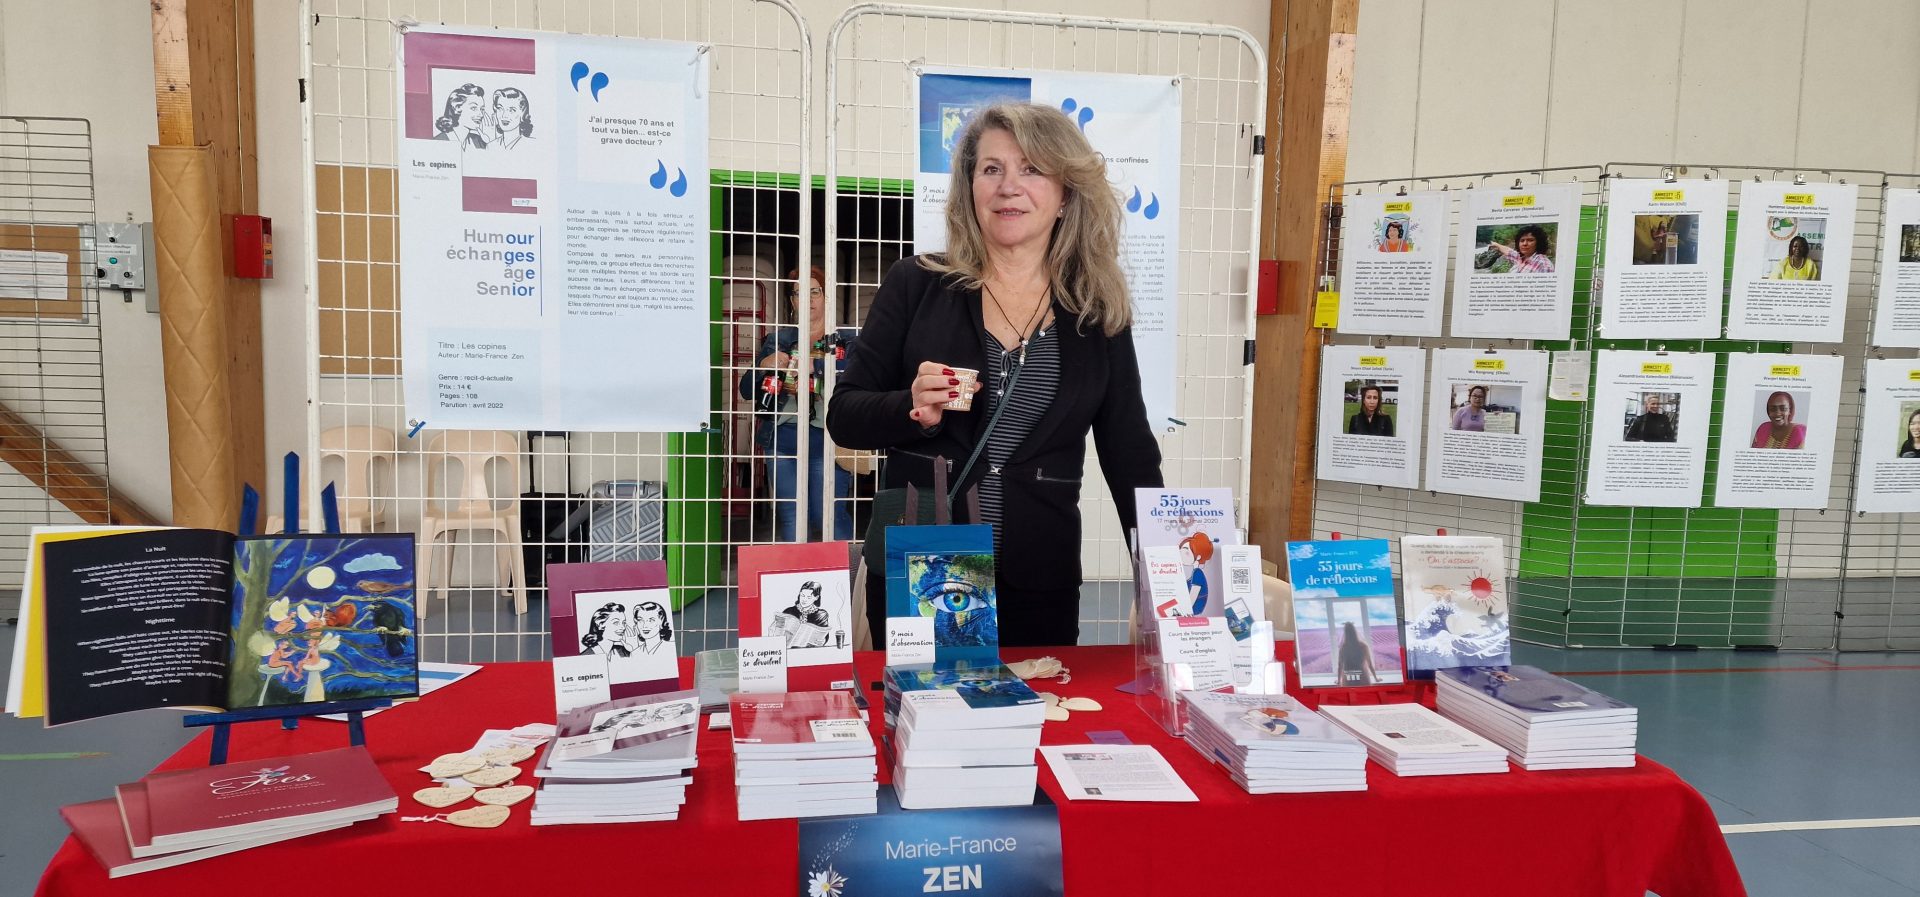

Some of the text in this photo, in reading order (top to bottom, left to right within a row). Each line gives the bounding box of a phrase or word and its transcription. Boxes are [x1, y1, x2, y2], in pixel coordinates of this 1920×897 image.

[589, 115, 602, 123] J'ai
[430, 161, 456, 169] copines
[464, 229, 534, 244] Humour
[447, 245, 535, 265] échanges
[504, 264, 535, 282] âge
[477, 281, 535, 296] Senior
[1160, 495, 1211, 508] 55 jours
[1150, 507, 1224, 517] de réflexions
[1318, 561, 1363, 573] 55 jours
[1306, 574, 1377, 585] de réflexions
[145, 617, 175, 625] Nighttime
[742, 649, 782, 658] Les copines
[753, 657, 782, 667] dévoilent
[578, 673, 604, 682] copines
[885, 836, 1017, 860] Marie-France
[922, 863, 983, 893] ZEN
